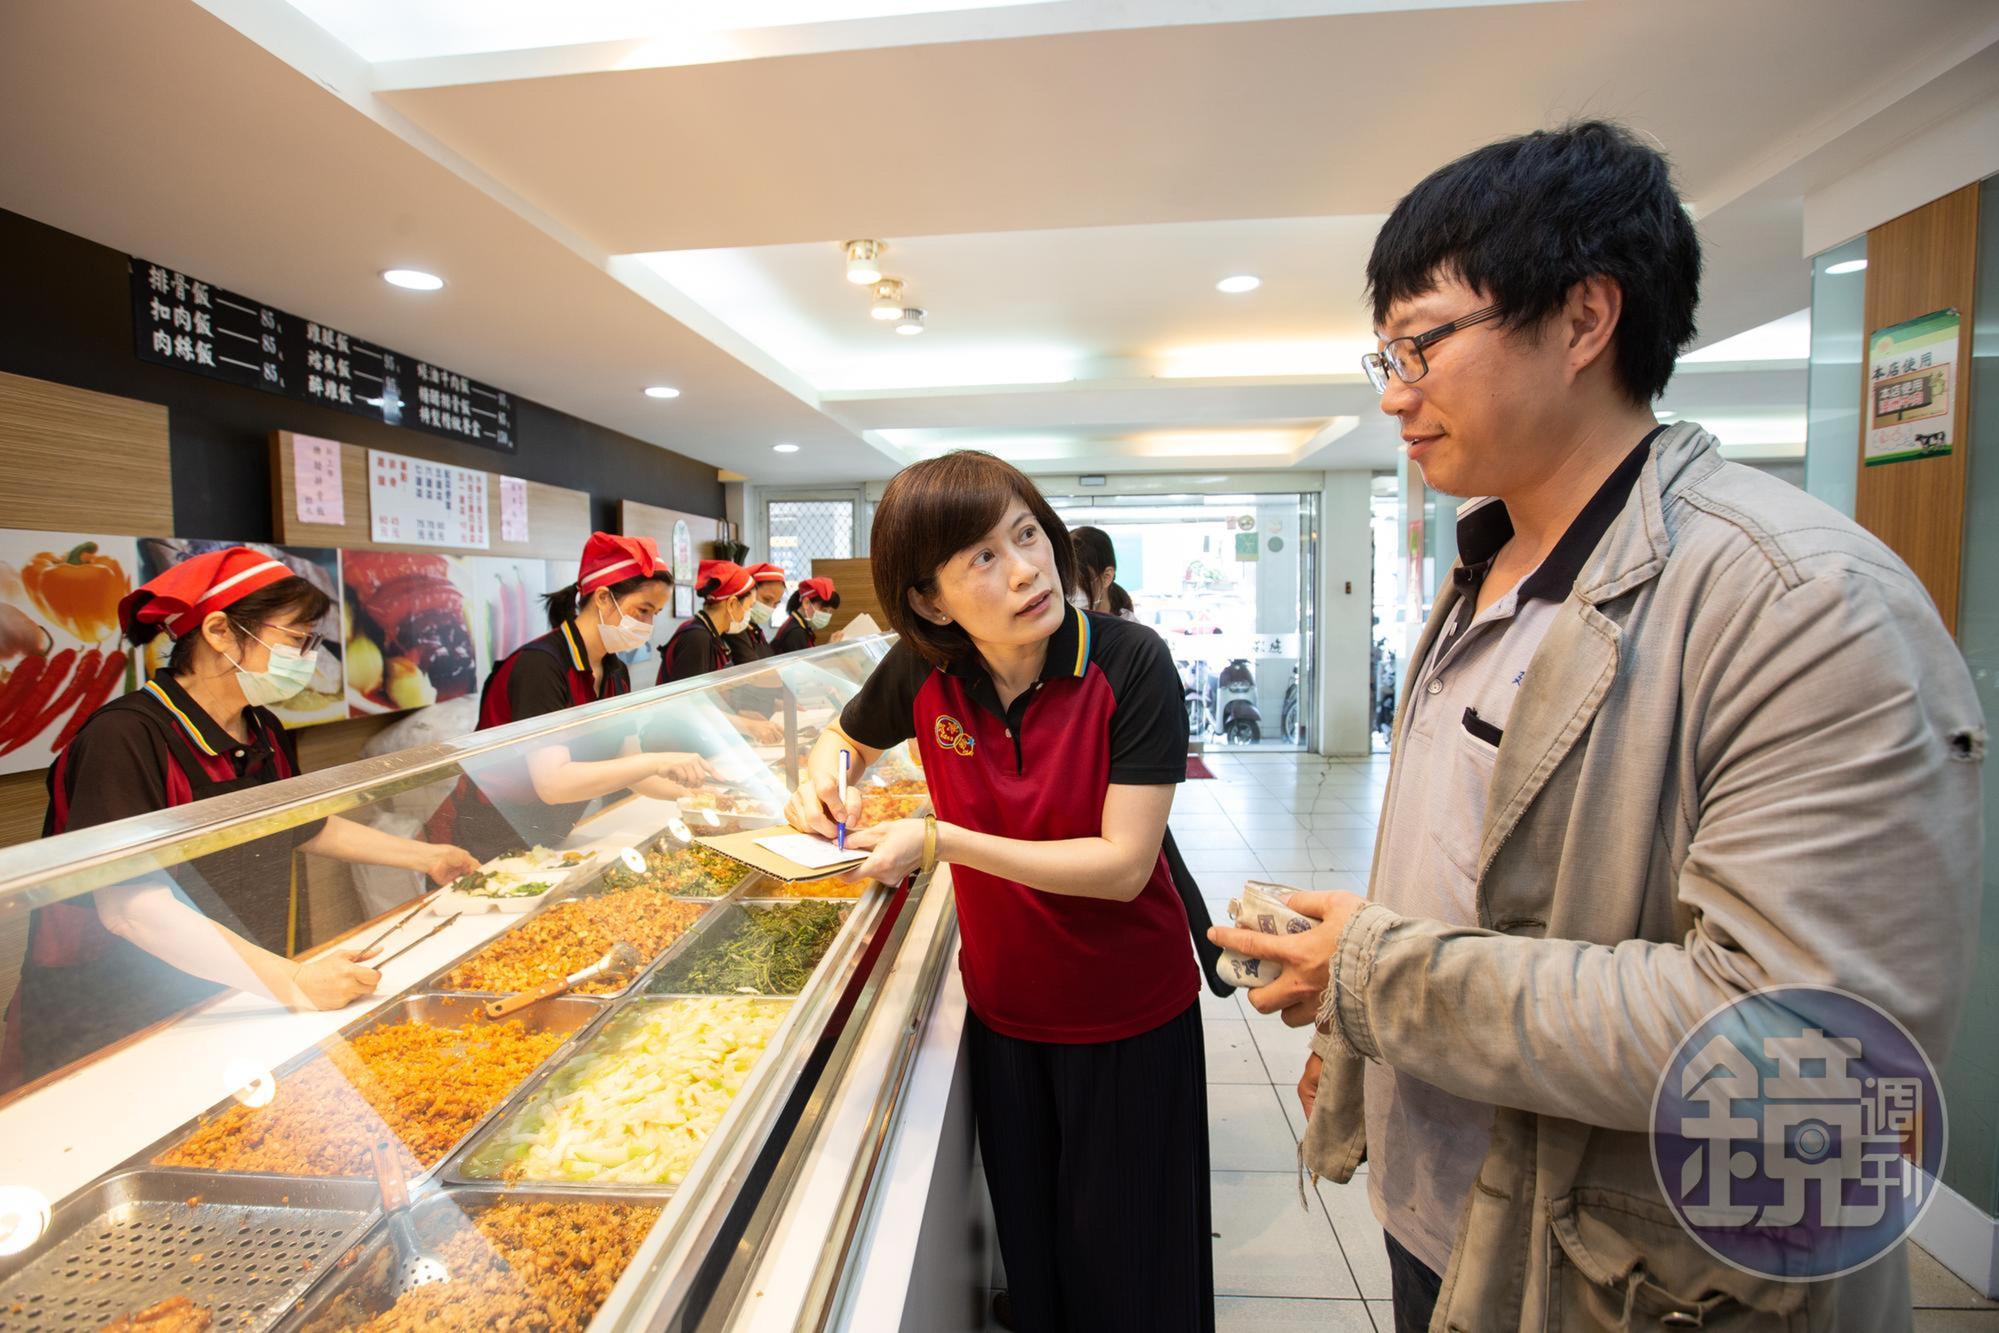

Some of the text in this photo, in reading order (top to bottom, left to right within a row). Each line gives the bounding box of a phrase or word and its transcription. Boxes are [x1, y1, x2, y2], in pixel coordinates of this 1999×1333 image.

[148, 264, 213, 309] 排骨飯
[150, 296, 215, 338] 扣肉飯
[153, 328, 217, 368] 肉絲飯
[1872, 351, 1933, 380] 本店使用
